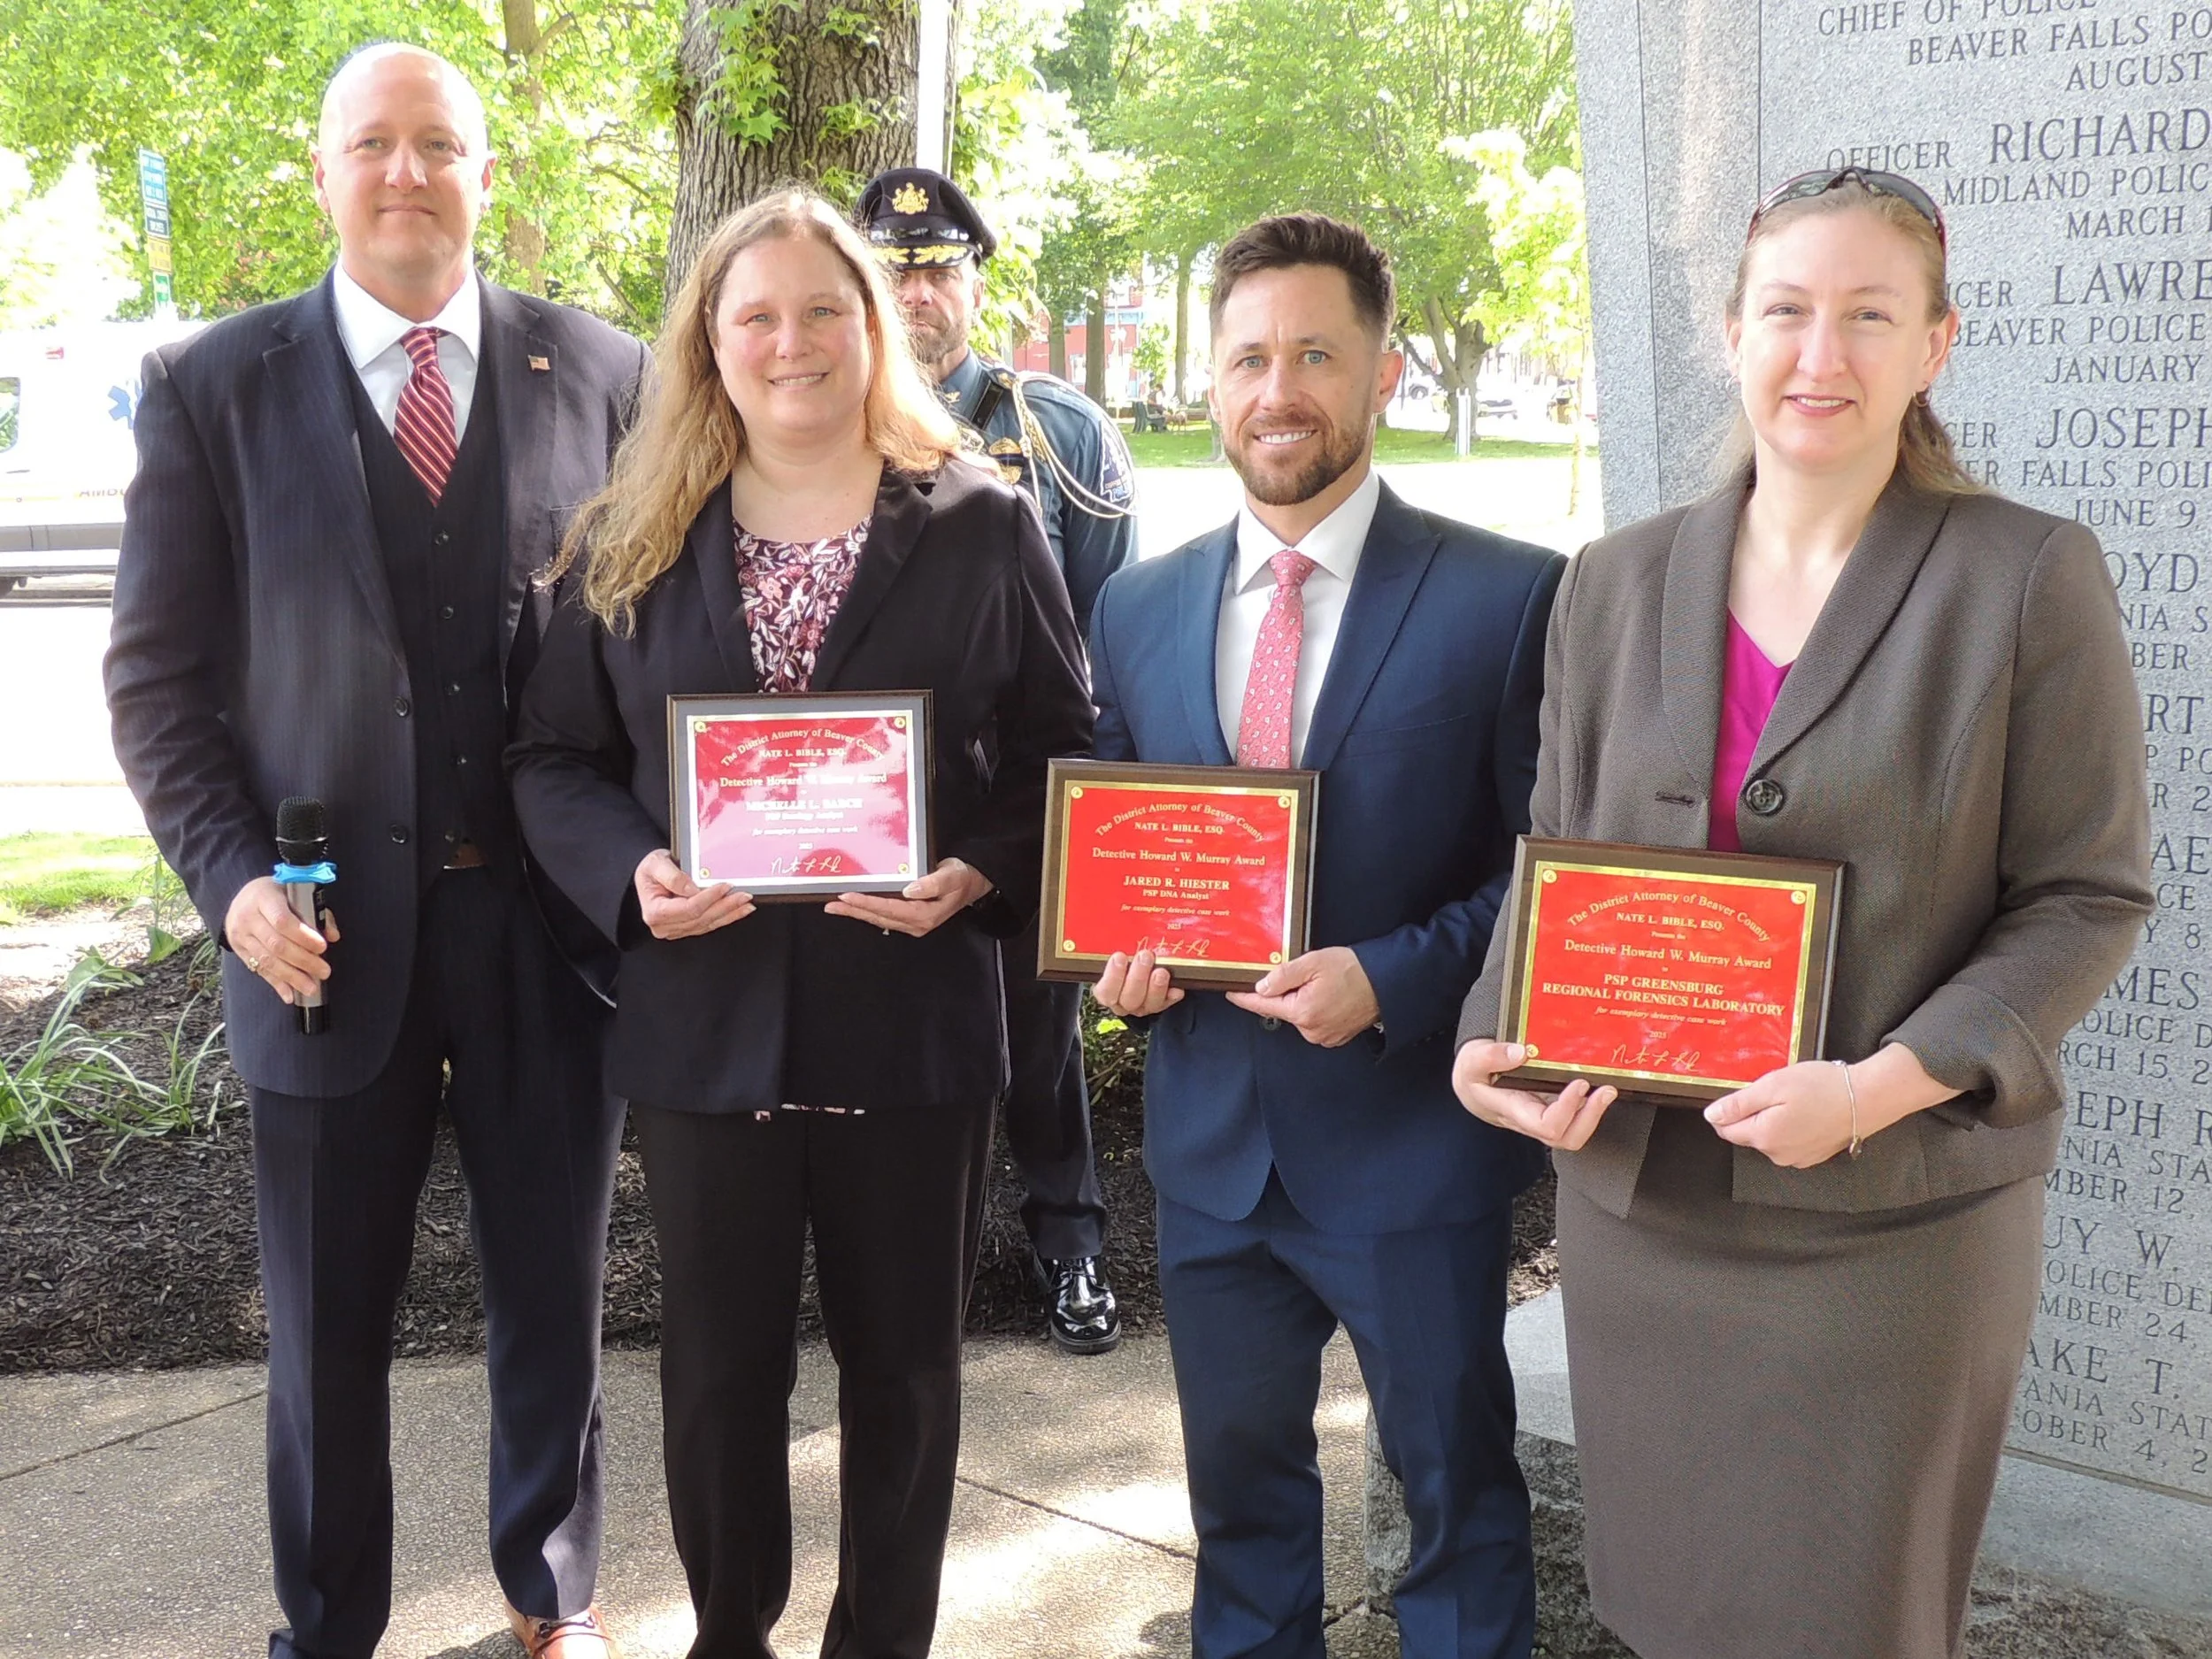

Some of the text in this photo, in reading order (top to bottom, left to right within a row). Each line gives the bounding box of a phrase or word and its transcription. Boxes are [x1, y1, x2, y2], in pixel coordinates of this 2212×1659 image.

[1818, 1, 1905, 36] CHIEF
[1924, 0, 1962, 25] OF
[1908, 9, 2212, 65] BEAVER FALLS PO
[2065, 50, 2208, 91] AUGUST
[1827, 107, 2211, 172] OFFICER RICHARD
[1943, 162, 2209, 206] MIDLAND POLIC
[2067, 204, 2185, 239] MARCH
[2051, 259, 2212, 305] LAWRE
[2088, 313, 2207, 344] POLICE
[2045, 354, 2204, 384] JANUARY
[2021, 460, 2117, 488] FALLS
[2138, 460, 2212, 488] POLI
[2074, 499, 2196, 529] JUNE 9
[2131, 641, 2190, 671] BER
[2145, 694, 2205, 733] RT
[720, 752, 738, 766] The
[737, 734, 770, 754] District
[771, 729, 809, 741] Attorney
[811, 728, 823, 737] of
[824, 729, 856, 743] Beaver
[719, 777, 764, 787] Detective
[1094, 803, 1264, 843] The District Attorney of Beaver County
[1134, 821, 1158, 831] NATE
[1172, 823, 1202, 834] BIBLE,
[1092, 847, 1266, 866] Detective Howard W. Murray Award
[2151, 833, 2210, 874] AE
[1123, 875, 1230, 891] JARED R. HIESTER
[1142, 888, 1210, 901] PSP DNA Analyst
[2156, 882, 2197, 911] CE
[1567, 892, 1770, 942] The District Attorney of Beaver County
[1616, 912, 1724, 932] NATE L. BIBLE, ESQ.
[1564, 938, 1772, 970] Detective Howard W. Murray Award
[1542, 982, 1786, 1017] REGIONAL FORENSICS LABORATORY
[1603, 973, 1724, 995] PSP GREENSBURG
[2103, 965, 2200, 1010] MES
[2082, 1009, 2174, 1044] OLICE
[2057, 1040, 2116, 1071] RCH
[2074, 1090, 2165, 1139] EPH
[2063, 1134, 2212, 1184] NIA STA
[2134, 1229, 2178, 1271] W.
[2047, 1259, 2142, 1300] OLICE
[2039, 1291, 2122, 1329] MBER
[2145, 1358, 2179, 1400] T.
[2023, 1409, 2108, 1452] OBER
[2129, 1401, 2212, 1440] STAT
